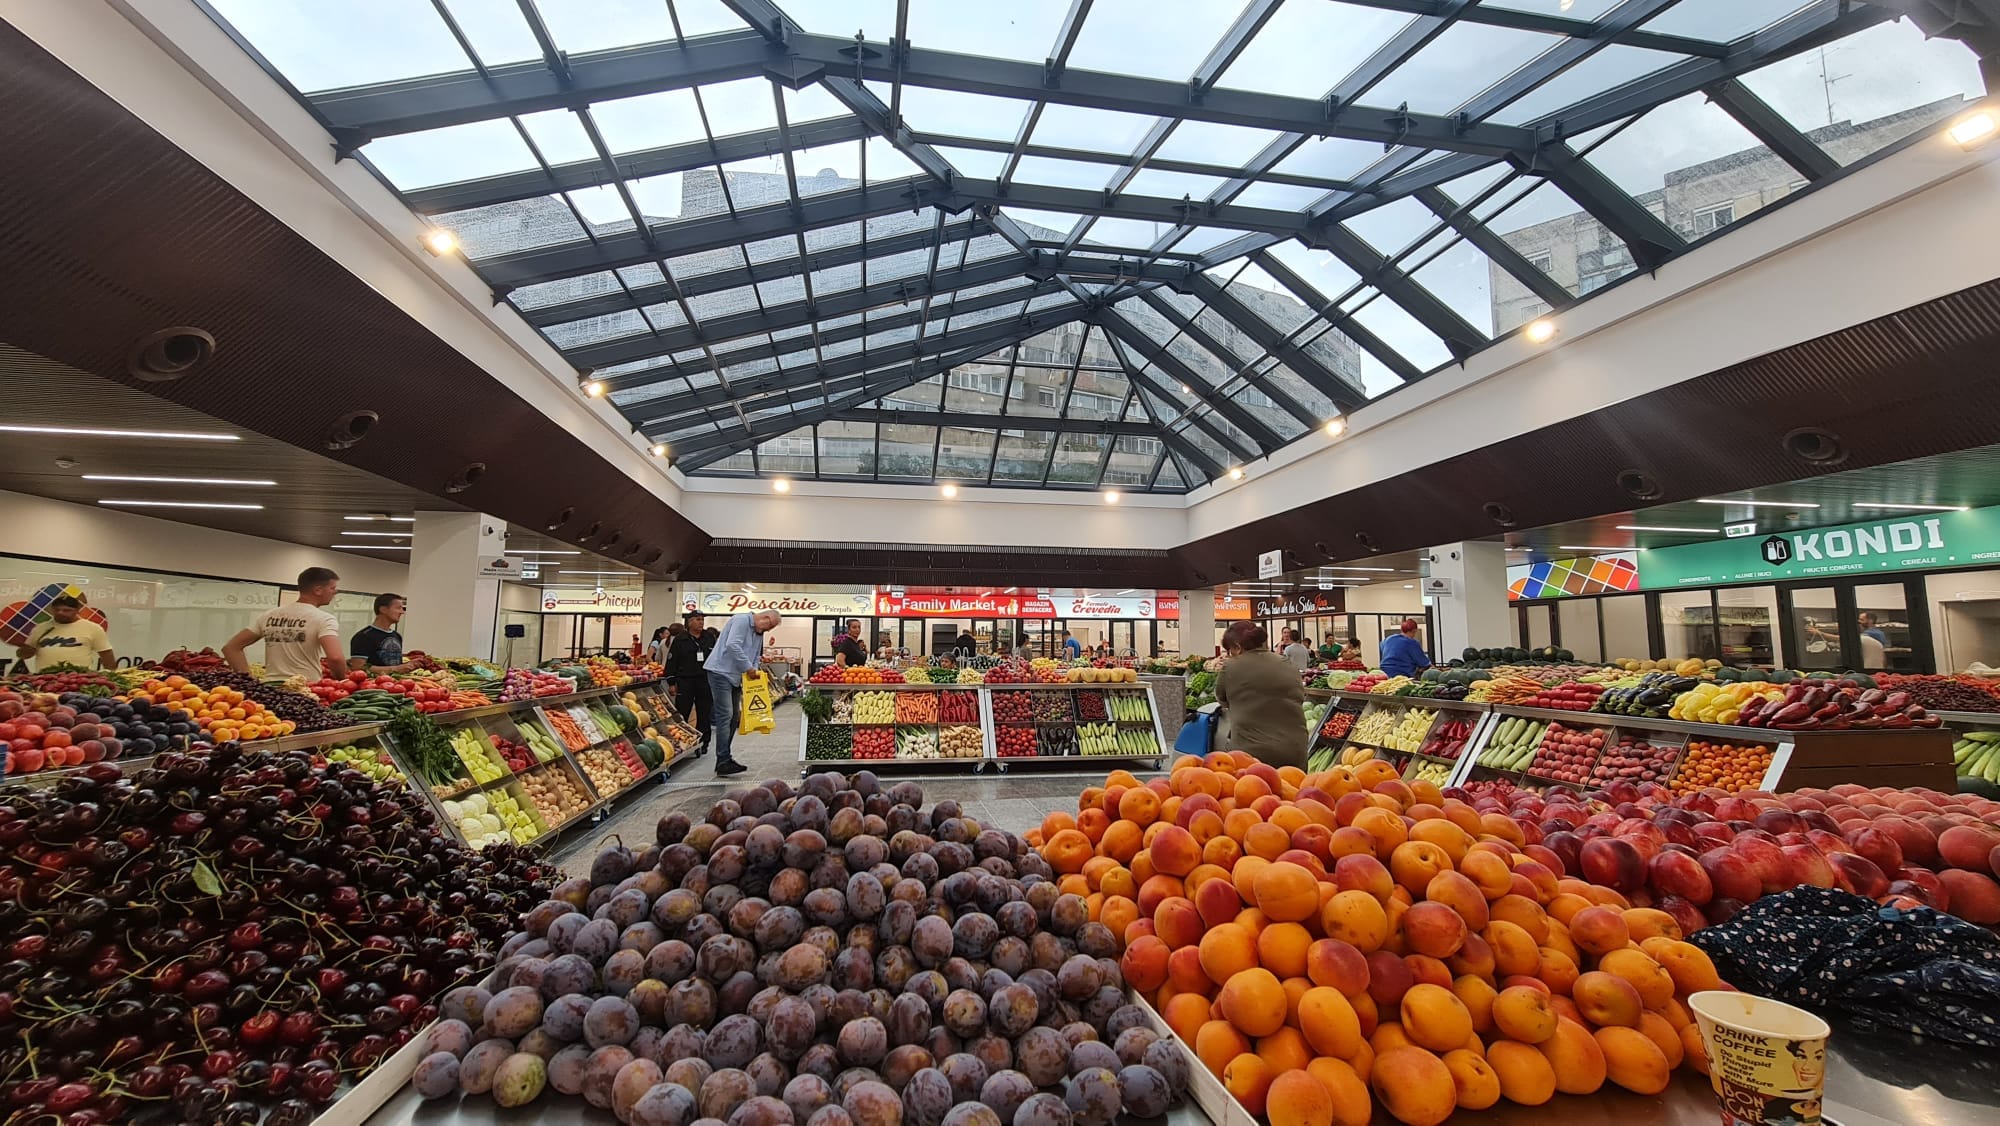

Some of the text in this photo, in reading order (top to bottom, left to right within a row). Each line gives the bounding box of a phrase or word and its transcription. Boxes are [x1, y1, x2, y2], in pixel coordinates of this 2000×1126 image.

[1793, 518, 1944, 561] KONDI
[1829, 563, 1863, 571] CONFIATE
[1901, 557, 1937, 566] CEREALE
[727, 594, 820, 612] Pescărie
[902, 598, 996, 613] Family Market
[1072, 604, 1121, 614] Crevedia
[1715, 1024, 1768, 1046] DRINK
[1713, 1034, 1776, 1058] COFFEE
[1720, 1048, 1771, 1068] Do Stupid
[1721, 1055, 1754, 1071] Things
[1723, 1062, 1753, 1076] Faster
[1723, 1069, 1774, 1087] with More
[1723, 1081, 1765, 1109] BON
